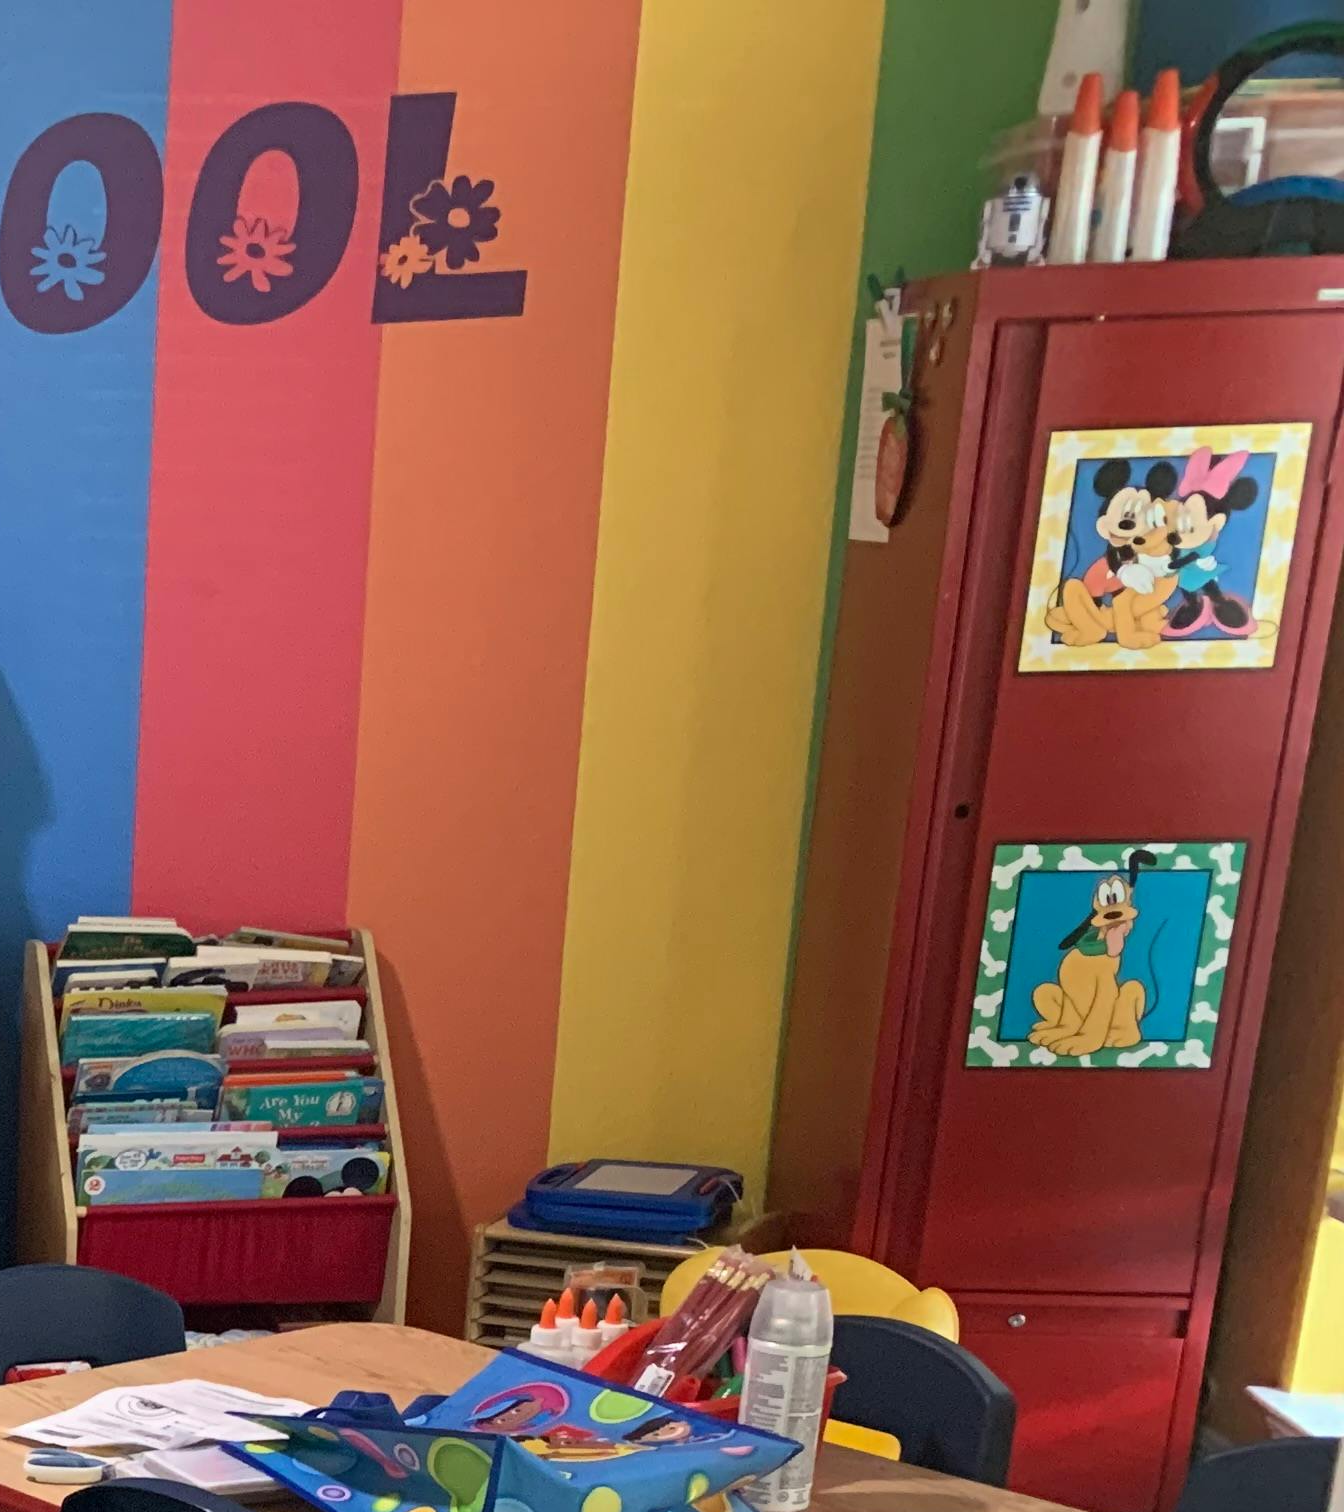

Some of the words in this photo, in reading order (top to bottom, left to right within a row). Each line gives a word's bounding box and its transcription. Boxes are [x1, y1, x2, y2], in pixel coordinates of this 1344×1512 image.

[259, 1097, 289, 1111] Are
[292, 1094, 321, 1107] You
[278, 1108, 304, 1123] My
[88, 1179, 103, 1192] 2
